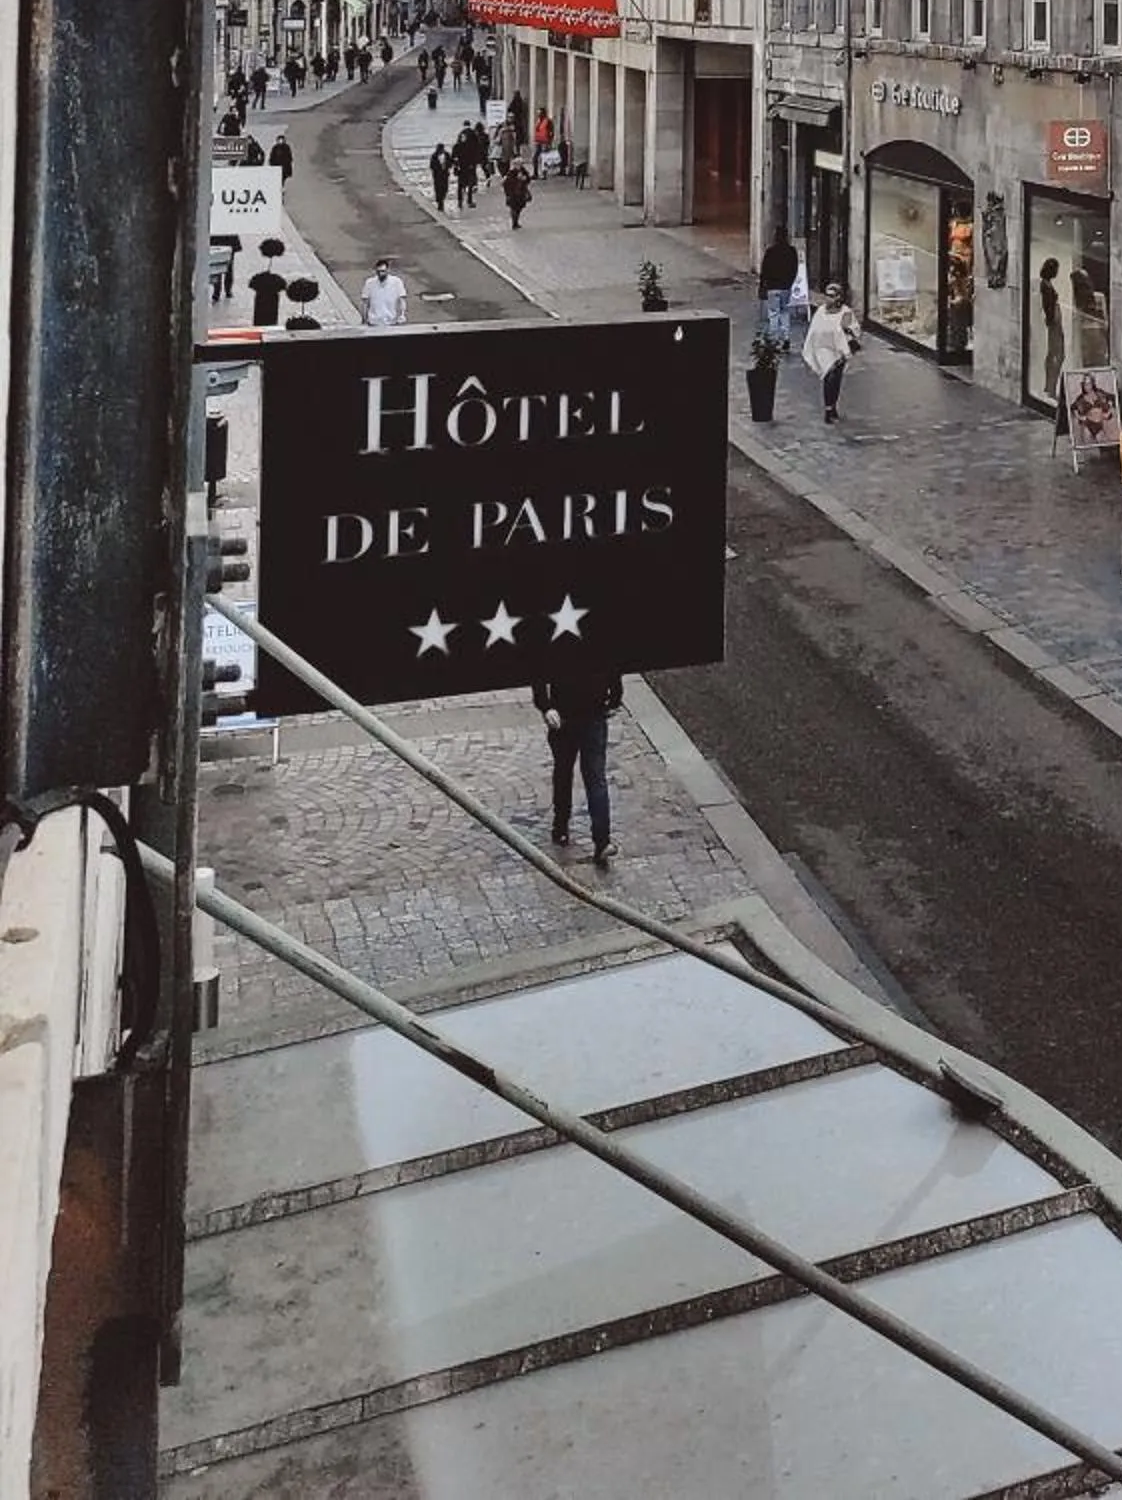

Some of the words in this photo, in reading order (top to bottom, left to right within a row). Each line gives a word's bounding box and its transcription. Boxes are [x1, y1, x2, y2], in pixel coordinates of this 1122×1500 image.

[357, 372, 646, 455] HÔTEL
[322, 506, 431, 565] DE
[471, 485, 675, 550] PARIS
